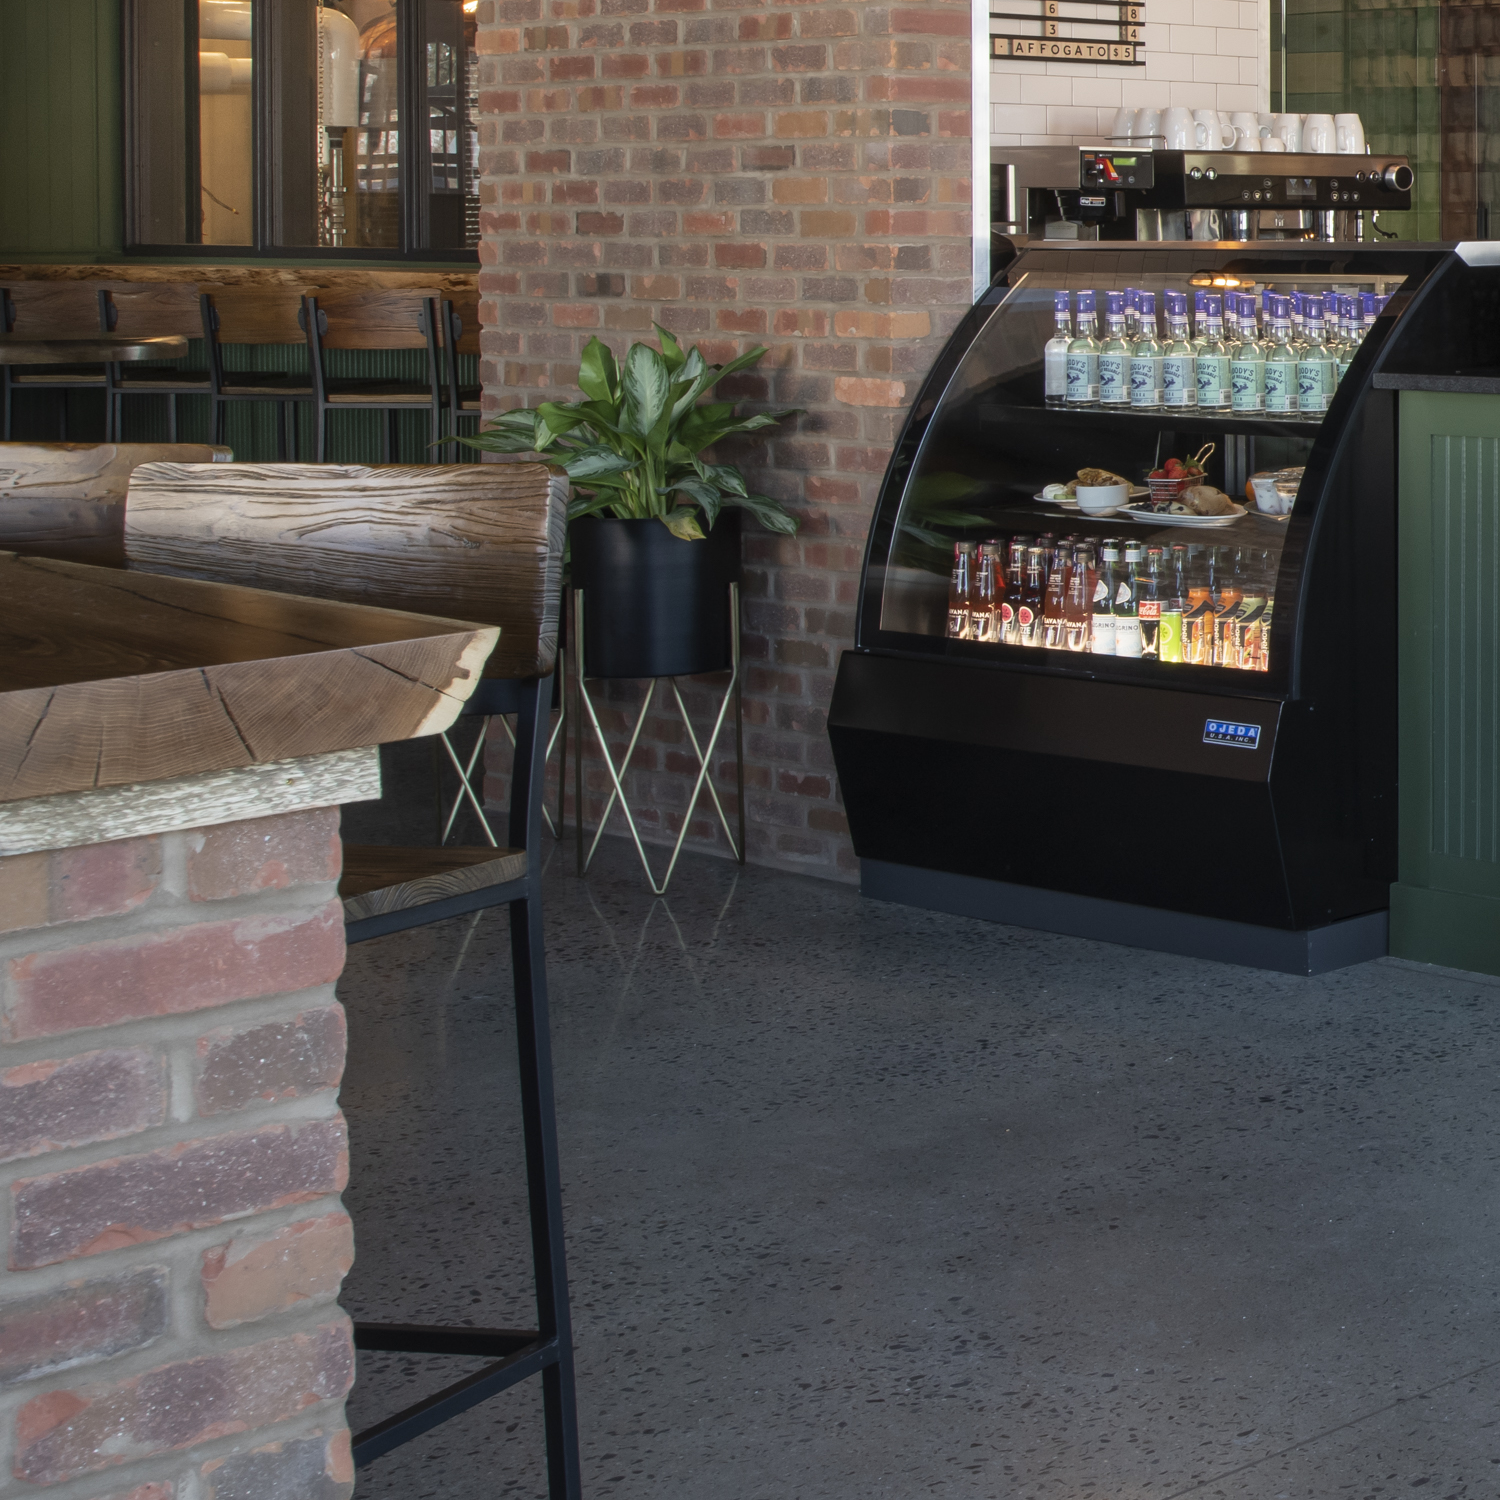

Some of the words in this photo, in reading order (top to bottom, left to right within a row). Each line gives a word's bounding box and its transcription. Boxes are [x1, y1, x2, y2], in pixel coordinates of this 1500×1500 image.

[1049, 3, 1055, 14] 6
[1131, 8, 1137, 19] 8
[1049, 24, 1056, 35] 3
[1130, 29, 1137, 39] 4
[1015, 42, 1106, 57] AFFOGATO
[1113, 47, 1130, 58] $5
[1209, 723, 1256, 737] OJEDA
